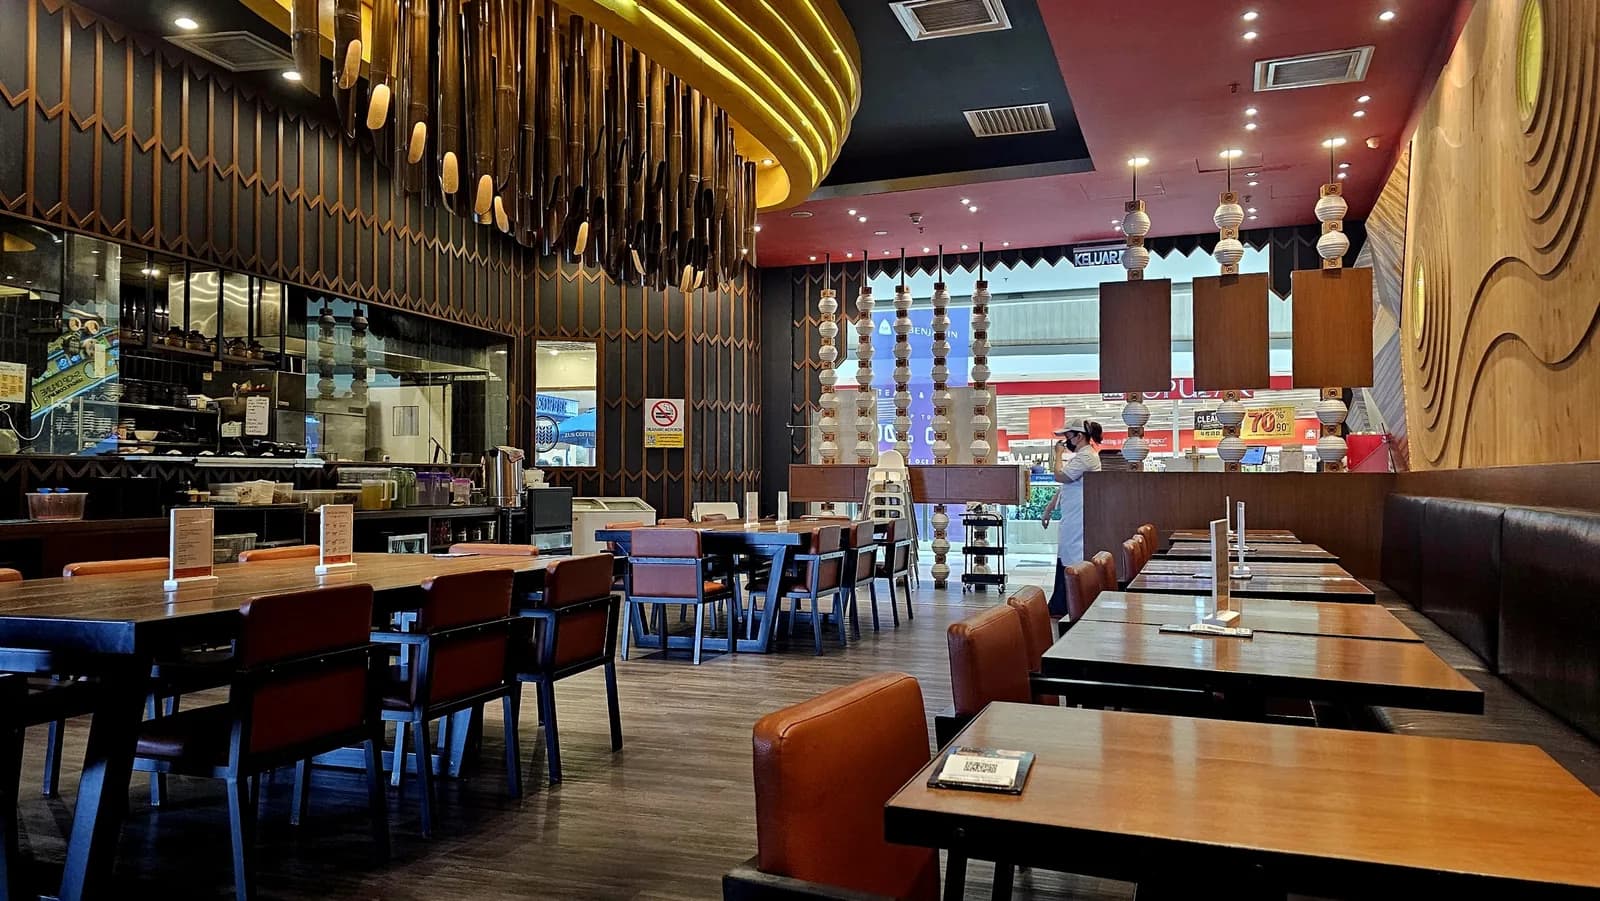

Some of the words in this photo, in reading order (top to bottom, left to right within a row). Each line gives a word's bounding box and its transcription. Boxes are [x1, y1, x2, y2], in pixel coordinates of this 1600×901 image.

[1074, 250, 1118, 266] KELUAR
[909, 326, 958, 338] BENJIN
[1197, 414, 1218, 423] CLEA
